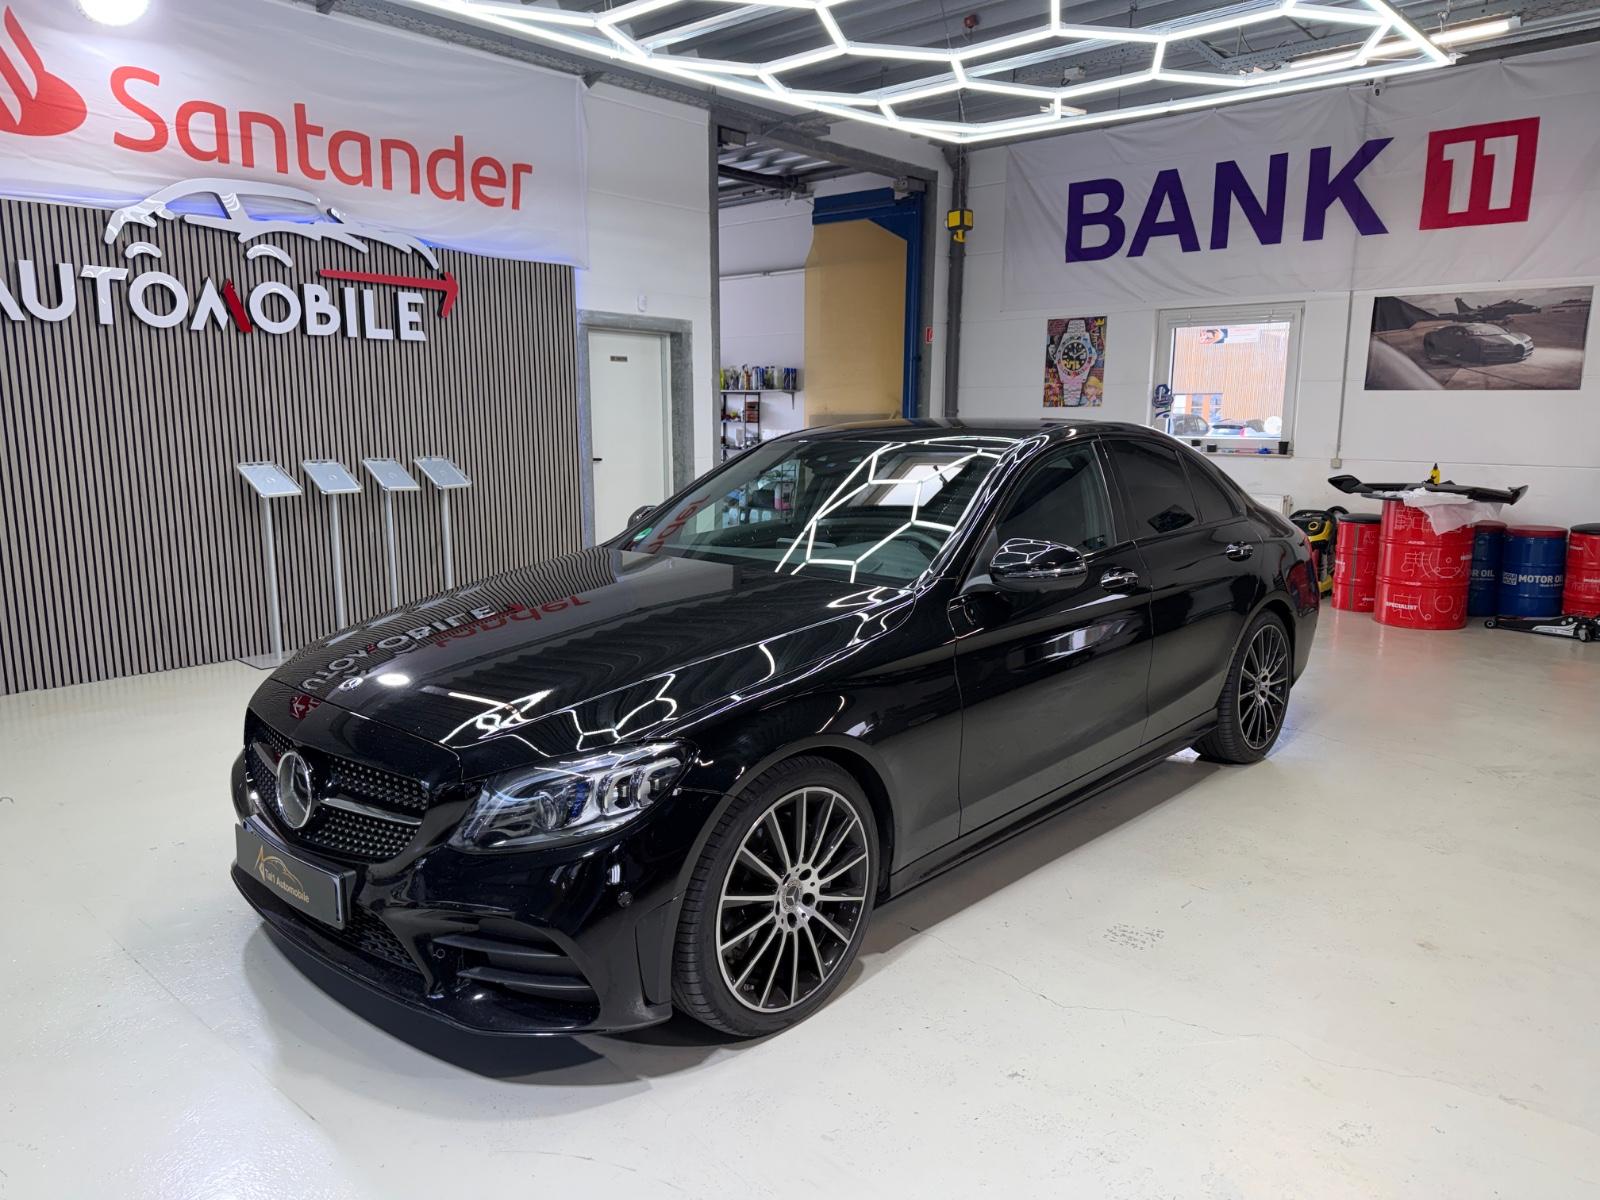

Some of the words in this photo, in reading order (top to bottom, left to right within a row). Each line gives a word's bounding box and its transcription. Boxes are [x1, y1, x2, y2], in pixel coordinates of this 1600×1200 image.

[110, 65, 533, 210] Santander
[1065, 137, 1393, 263] BANK
[1442, 135, 1518, 214] 11
[1481, 569, 1495, 577] OIL
[1518, 574, 1553, 584] MOTOR
[1384, 601, 1418, 611] SPECIALIST
[276, 876, 310, 903] Automobile
